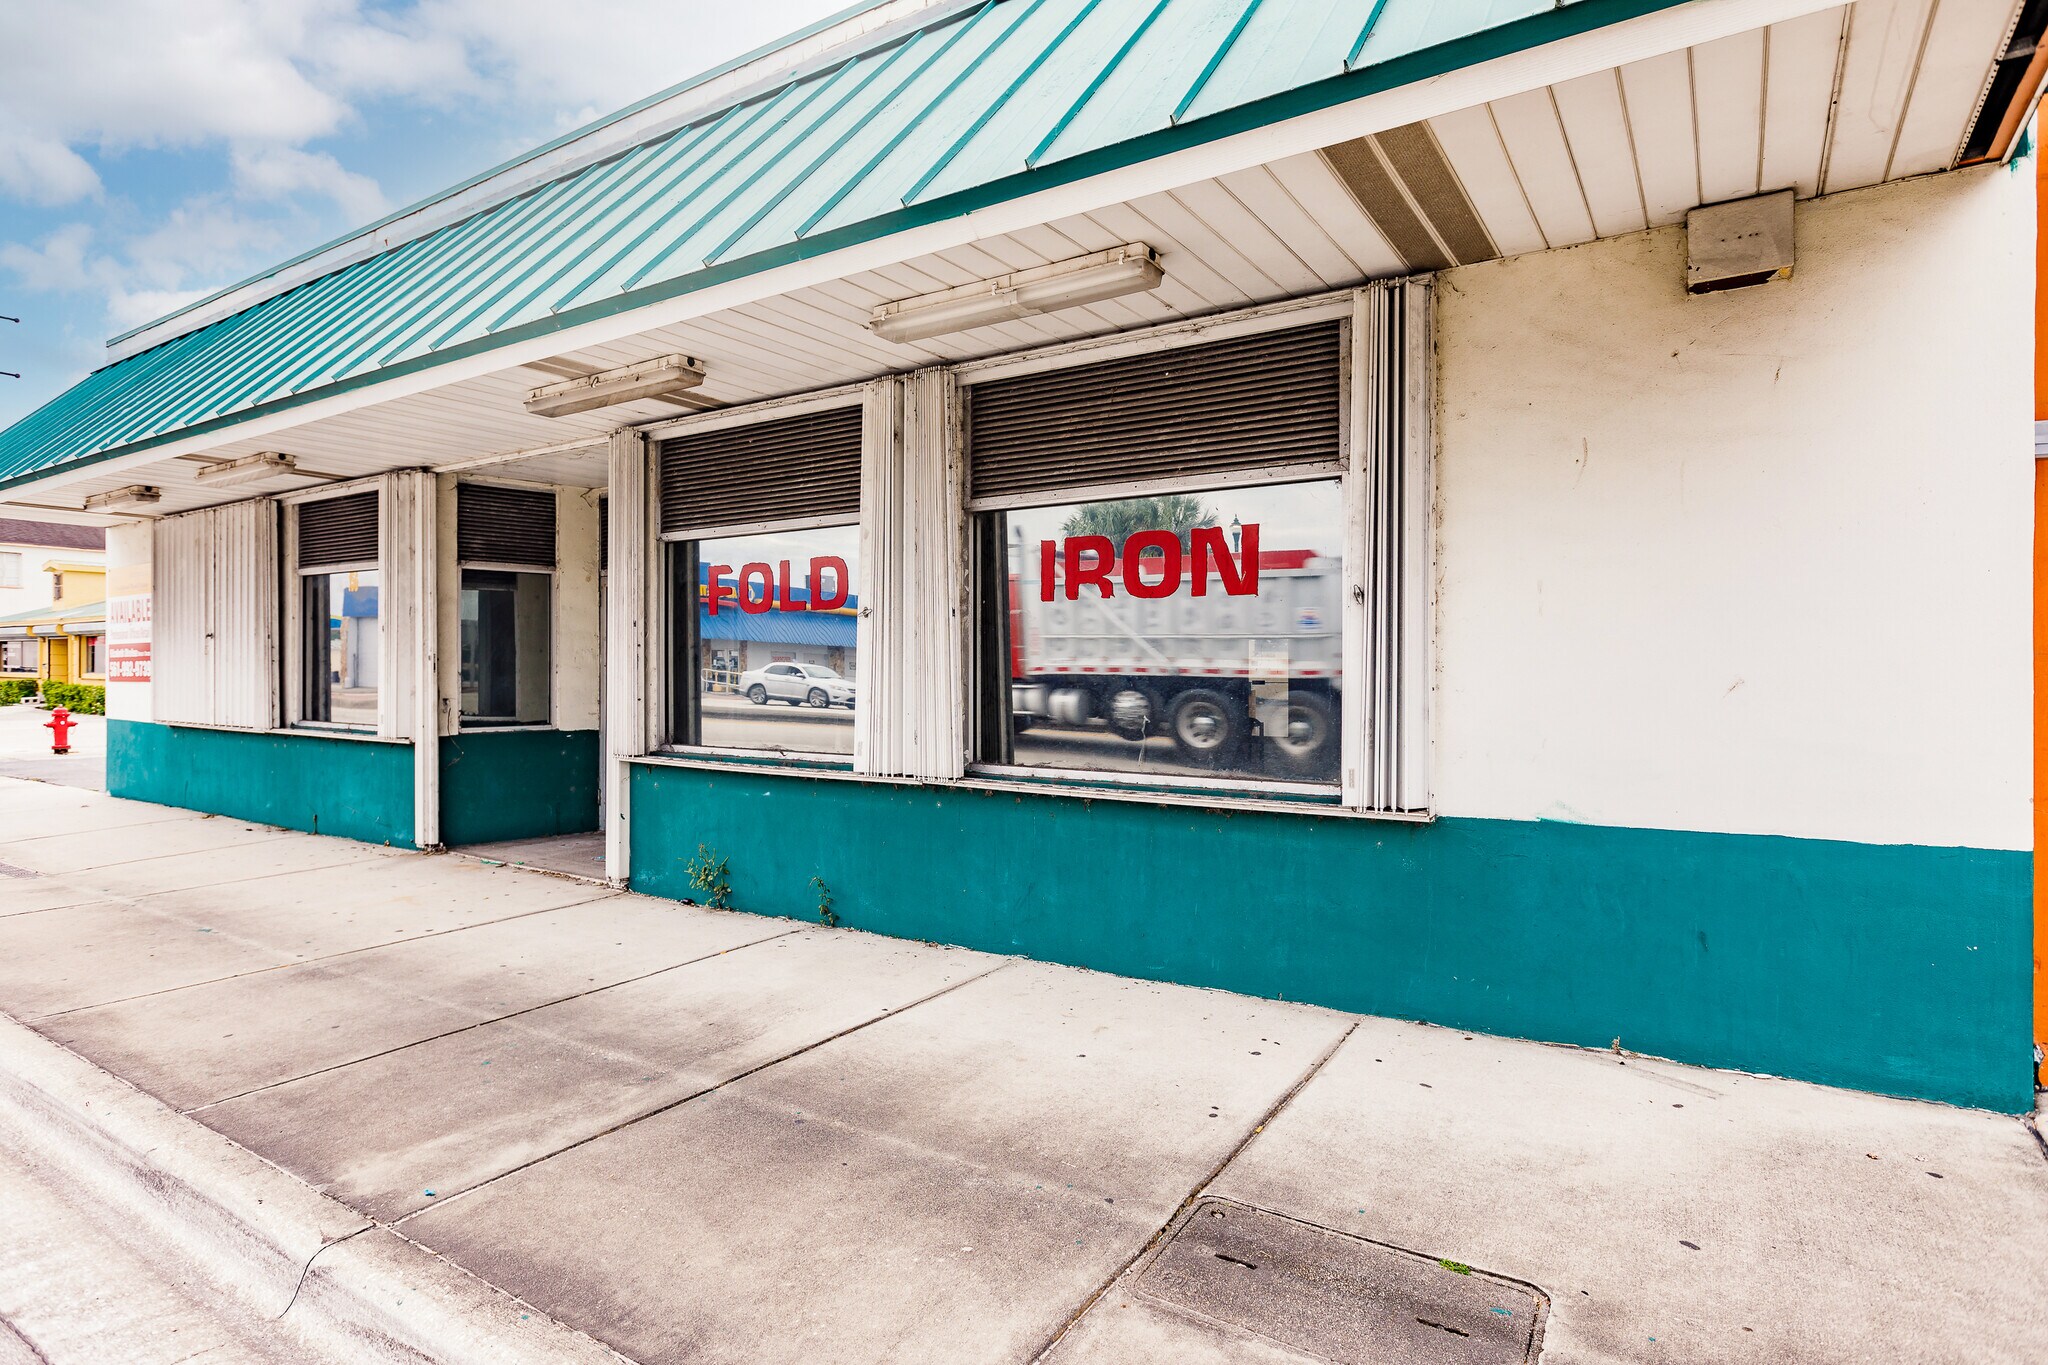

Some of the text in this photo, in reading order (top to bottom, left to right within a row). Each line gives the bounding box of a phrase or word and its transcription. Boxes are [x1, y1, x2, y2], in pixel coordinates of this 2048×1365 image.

[708, 556, 849, 615] FOLD
[1041, 523, 1260, 601] IRON
[111, 598, 151, 623] AVAILABLE
